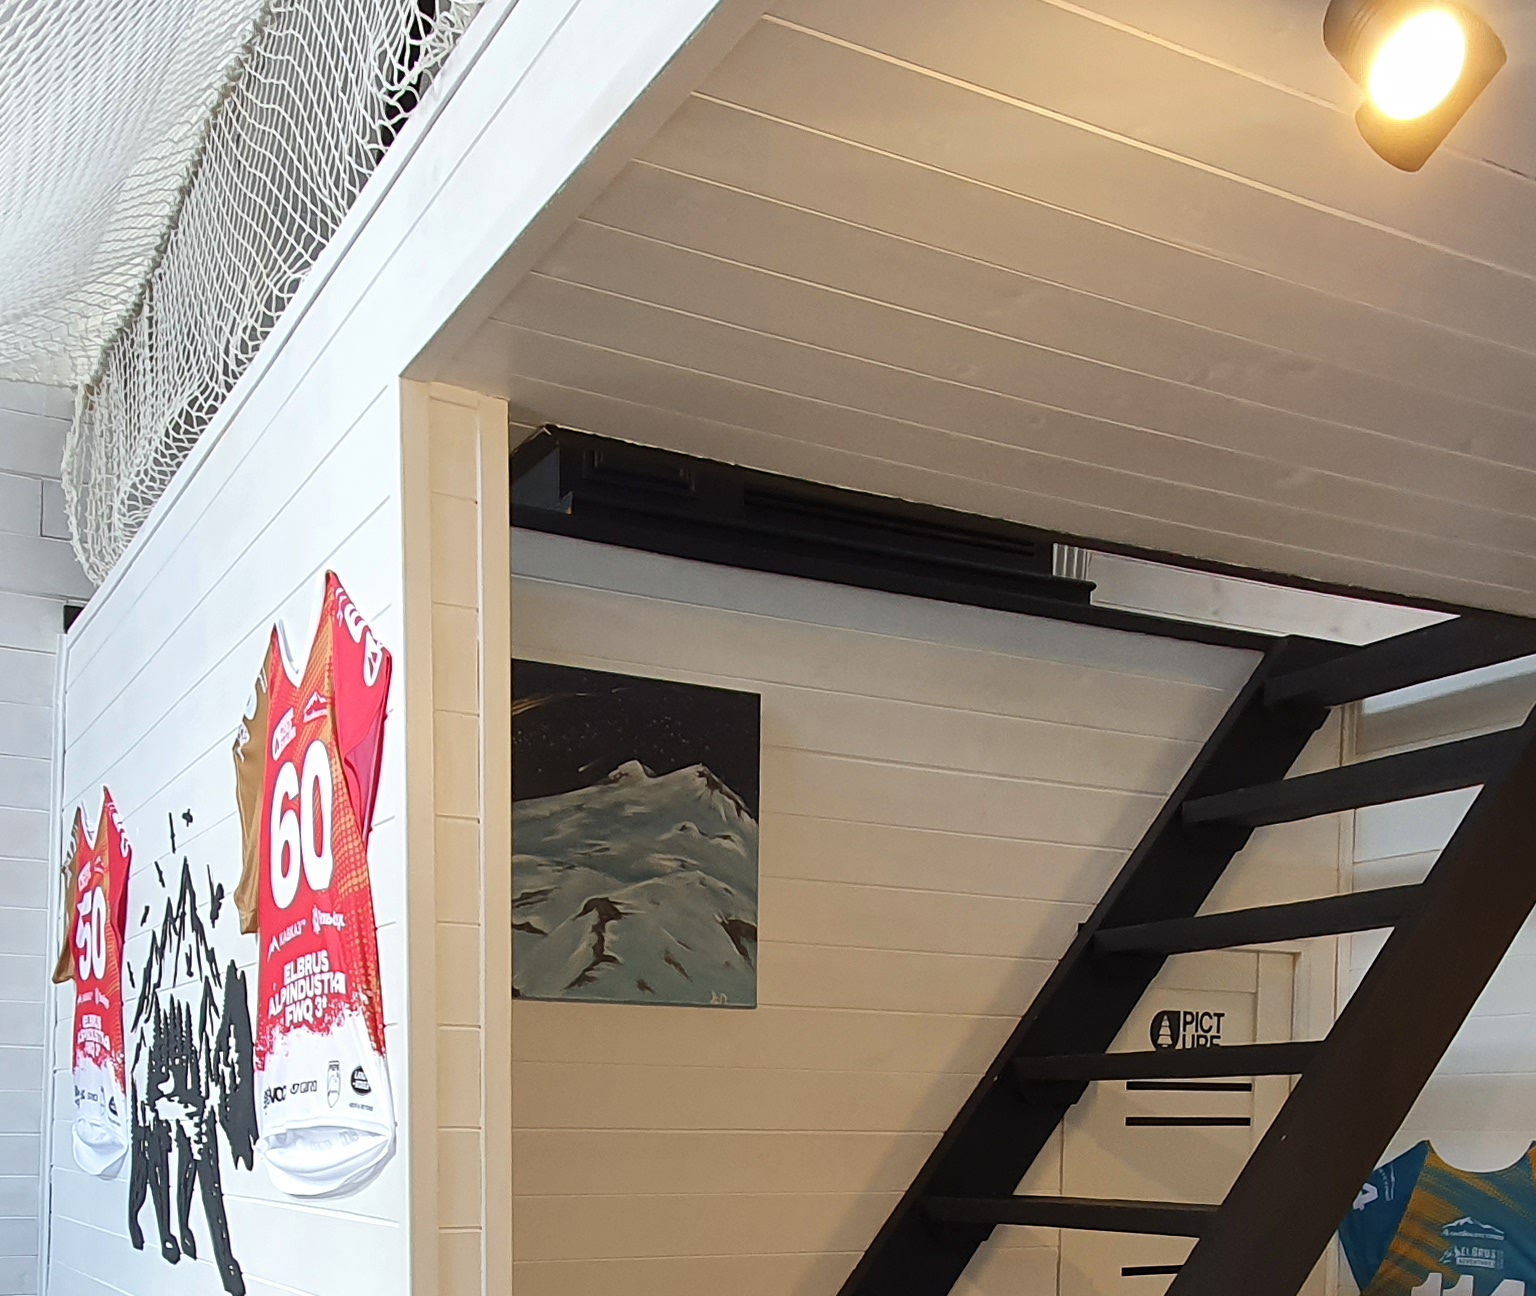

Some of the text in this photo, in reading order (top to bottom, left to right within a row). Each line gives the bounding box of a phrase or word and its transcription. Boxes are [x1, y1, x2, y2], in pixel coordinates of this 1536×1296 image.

[270, 740, 334, 909] 60
[76, 886, 107, 981] 50
[284, 949, 329, 986] ELBRUS
[285, 998, 314, 1027] FWQ
[1183, 1011, 1225, 1034] PICT
